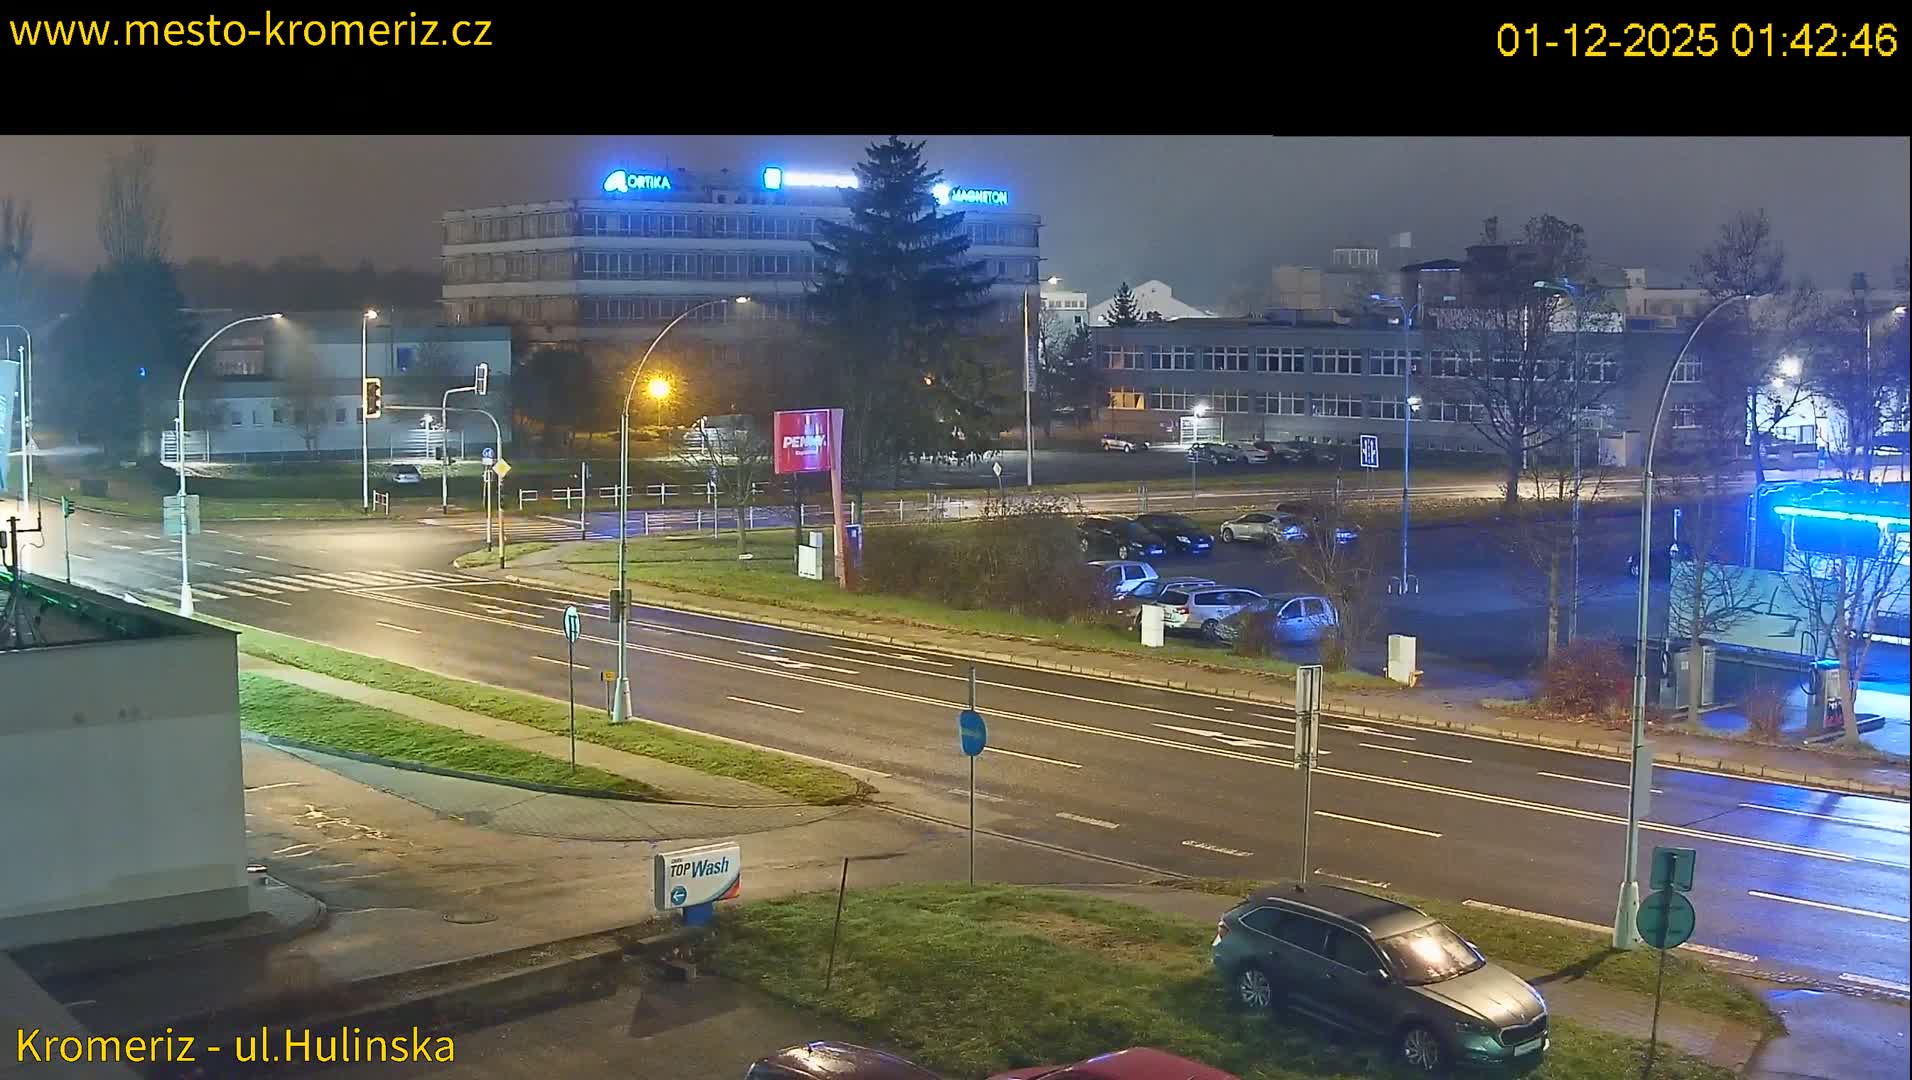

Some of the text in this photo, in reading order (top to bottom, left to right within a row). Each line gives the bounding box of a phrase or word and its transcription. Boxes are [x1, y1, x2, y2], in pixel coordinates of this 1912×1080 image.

[627, 174, 671, 189] ORTIKA
[671, 856, 730, 878] TOP Wash
